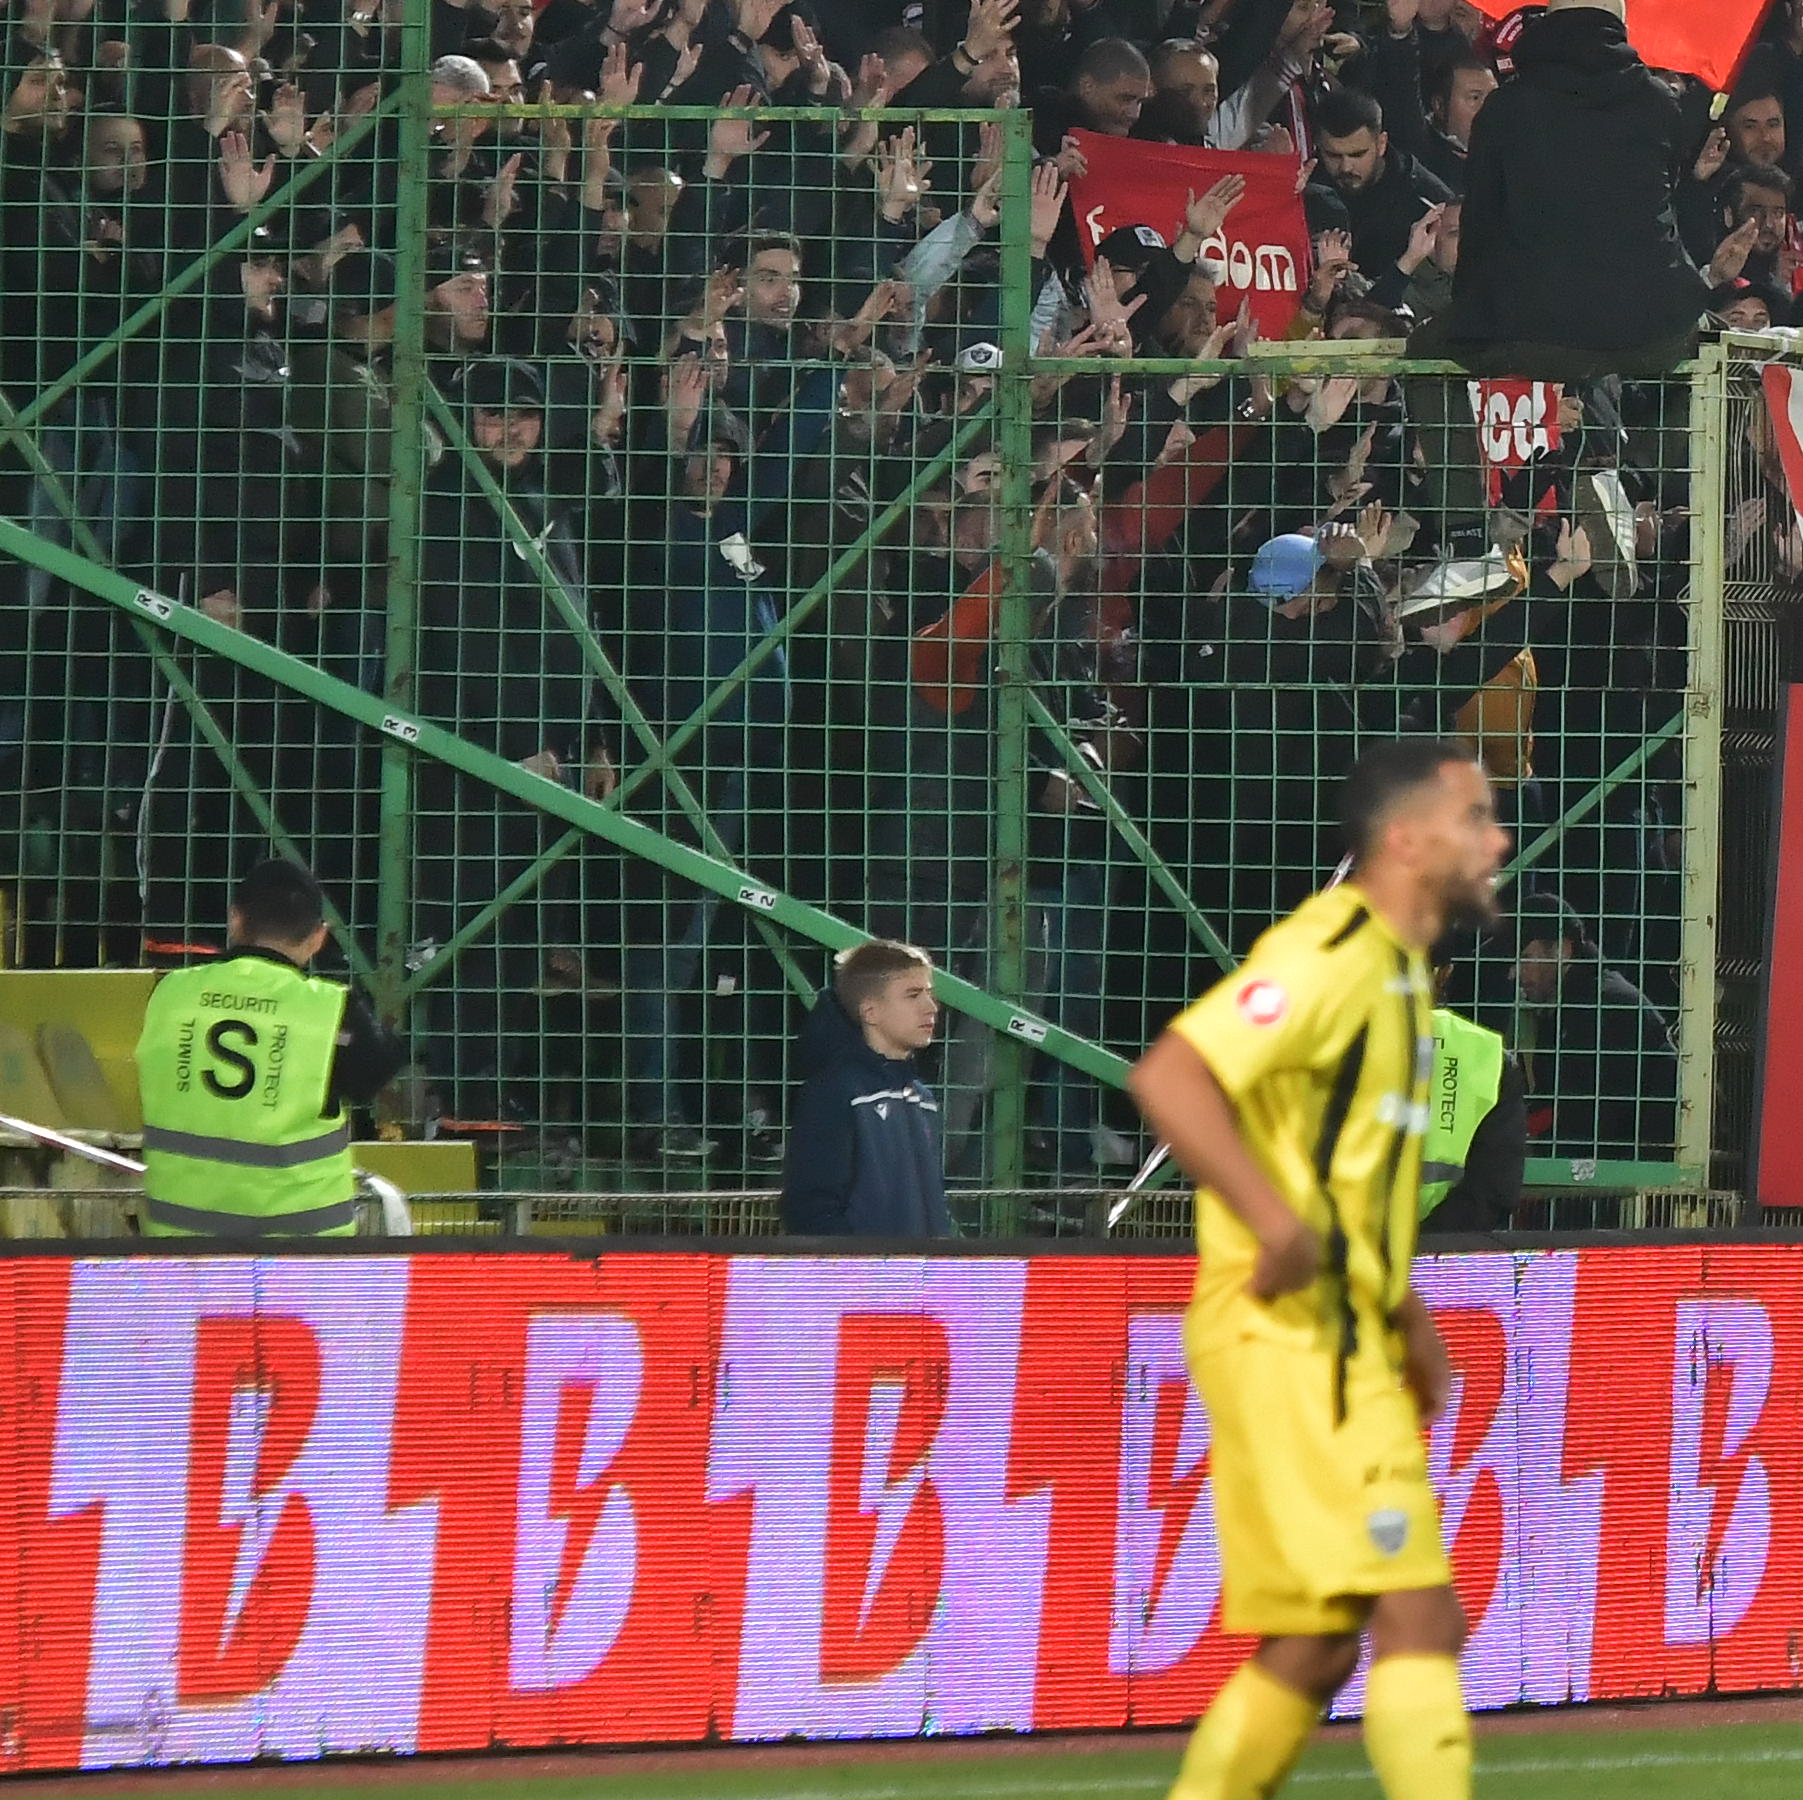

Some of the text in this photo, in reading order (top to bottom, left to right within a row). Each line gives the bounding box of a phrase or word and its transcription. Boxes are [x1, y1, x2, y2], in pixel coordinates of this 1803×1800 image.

[383, 719, 399, 731] R
[403, 726, 417, 738] 3
[740, 890, 754, 902] R
[760, 895, 775, 907] 2
[201, 1019, 259, 1101] S
[1010, 1019, 1026, 1032] R
[262, 1023, 288, 1112] PROTECT
[1440, 1056, 1459, 1135] PROTECT
[176, 1313, 321, 1706] B
[508, 1309, 643, 1693] B
[819, 1312, 951, 1688] B
[1663, 1299, 1776, 1646] B
